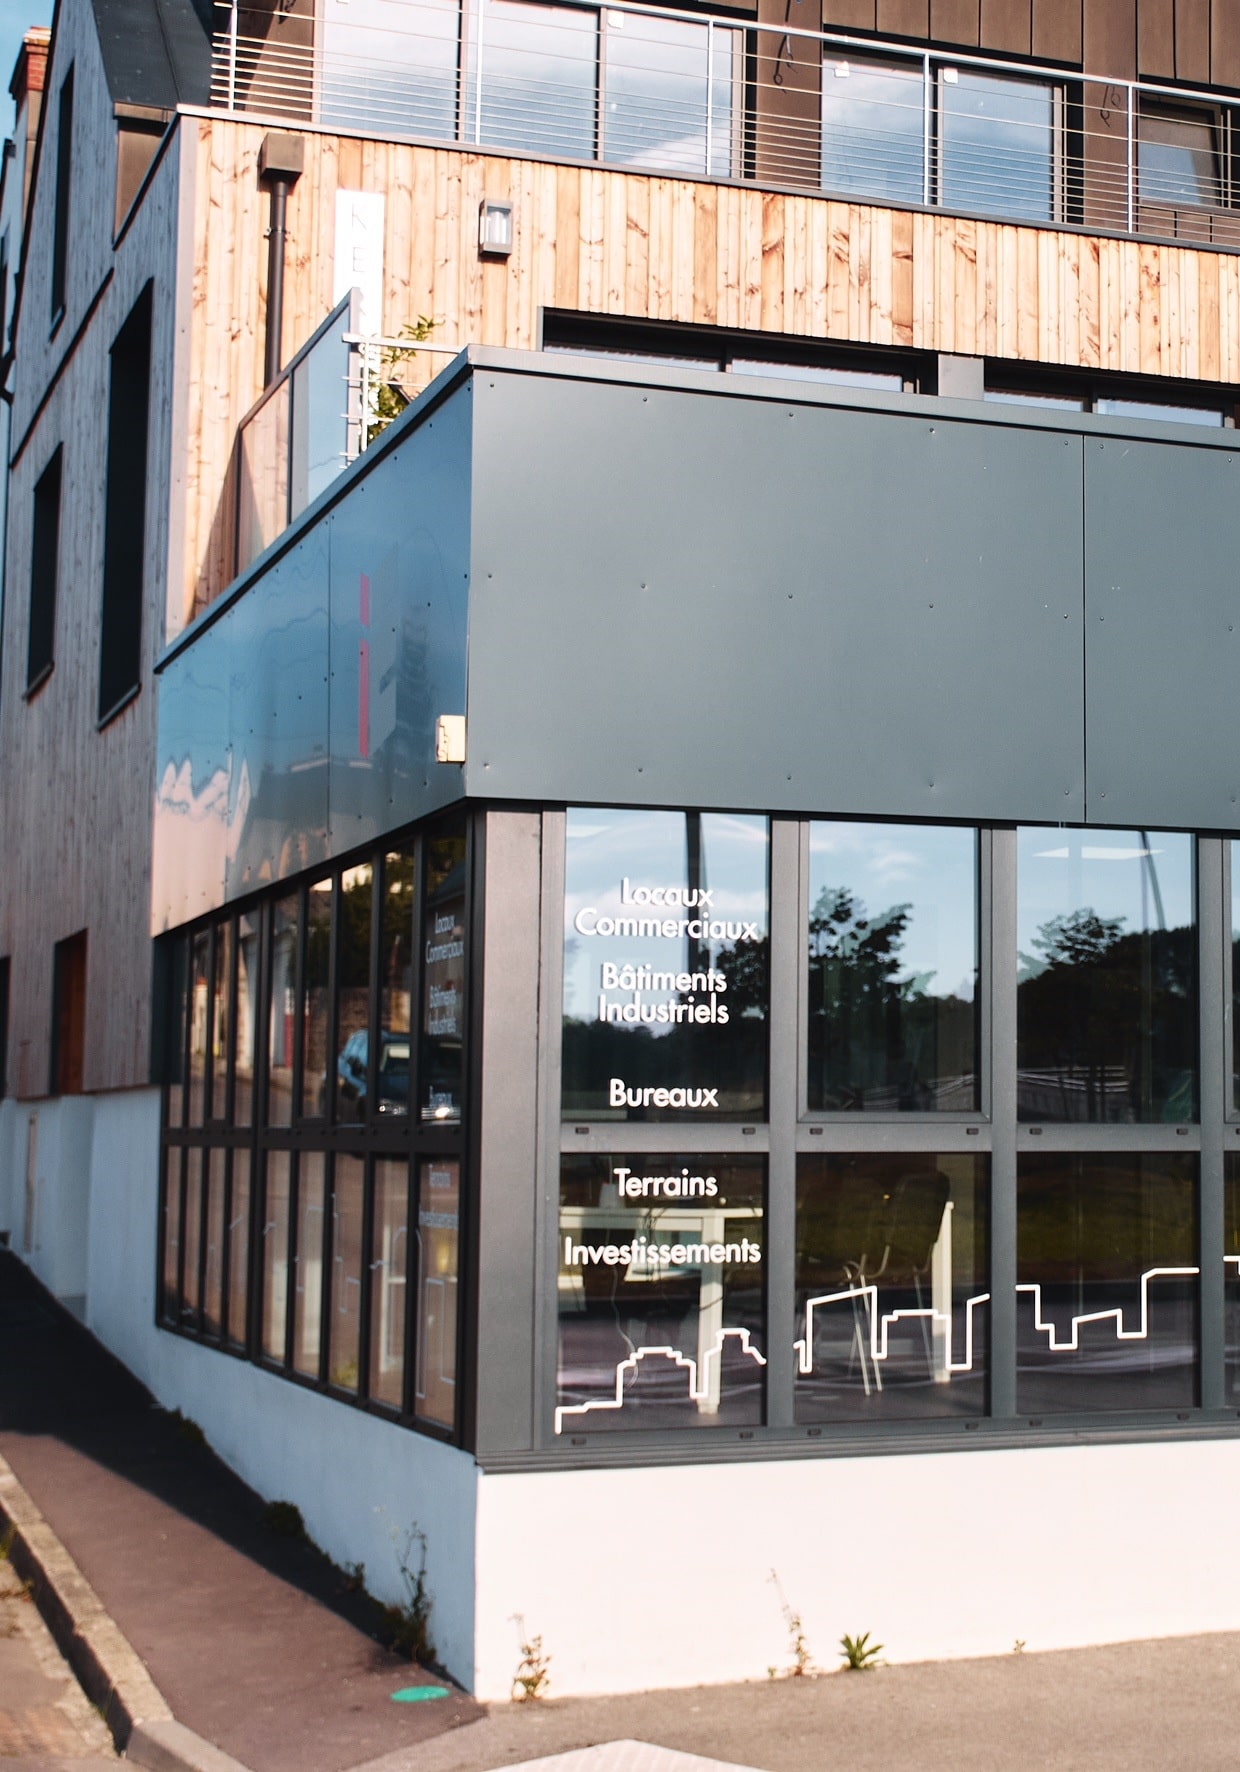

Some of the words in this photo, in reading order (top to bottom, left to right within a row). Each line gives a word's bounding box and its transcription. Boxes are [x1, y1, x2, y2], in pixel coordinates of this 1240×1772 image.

[621, 877, 714, 907] Locaux
[574, 908, 759, 940] Commerciaux
[601, 962, 728, 993] Bâtiments
[599, 993, 730, 1025] Industriels
[609, 1078, 719, 1108] Bureaux
[613, 1168, 718, 1197] Terrains
[564, 1236, 762, 1266] Investissements
